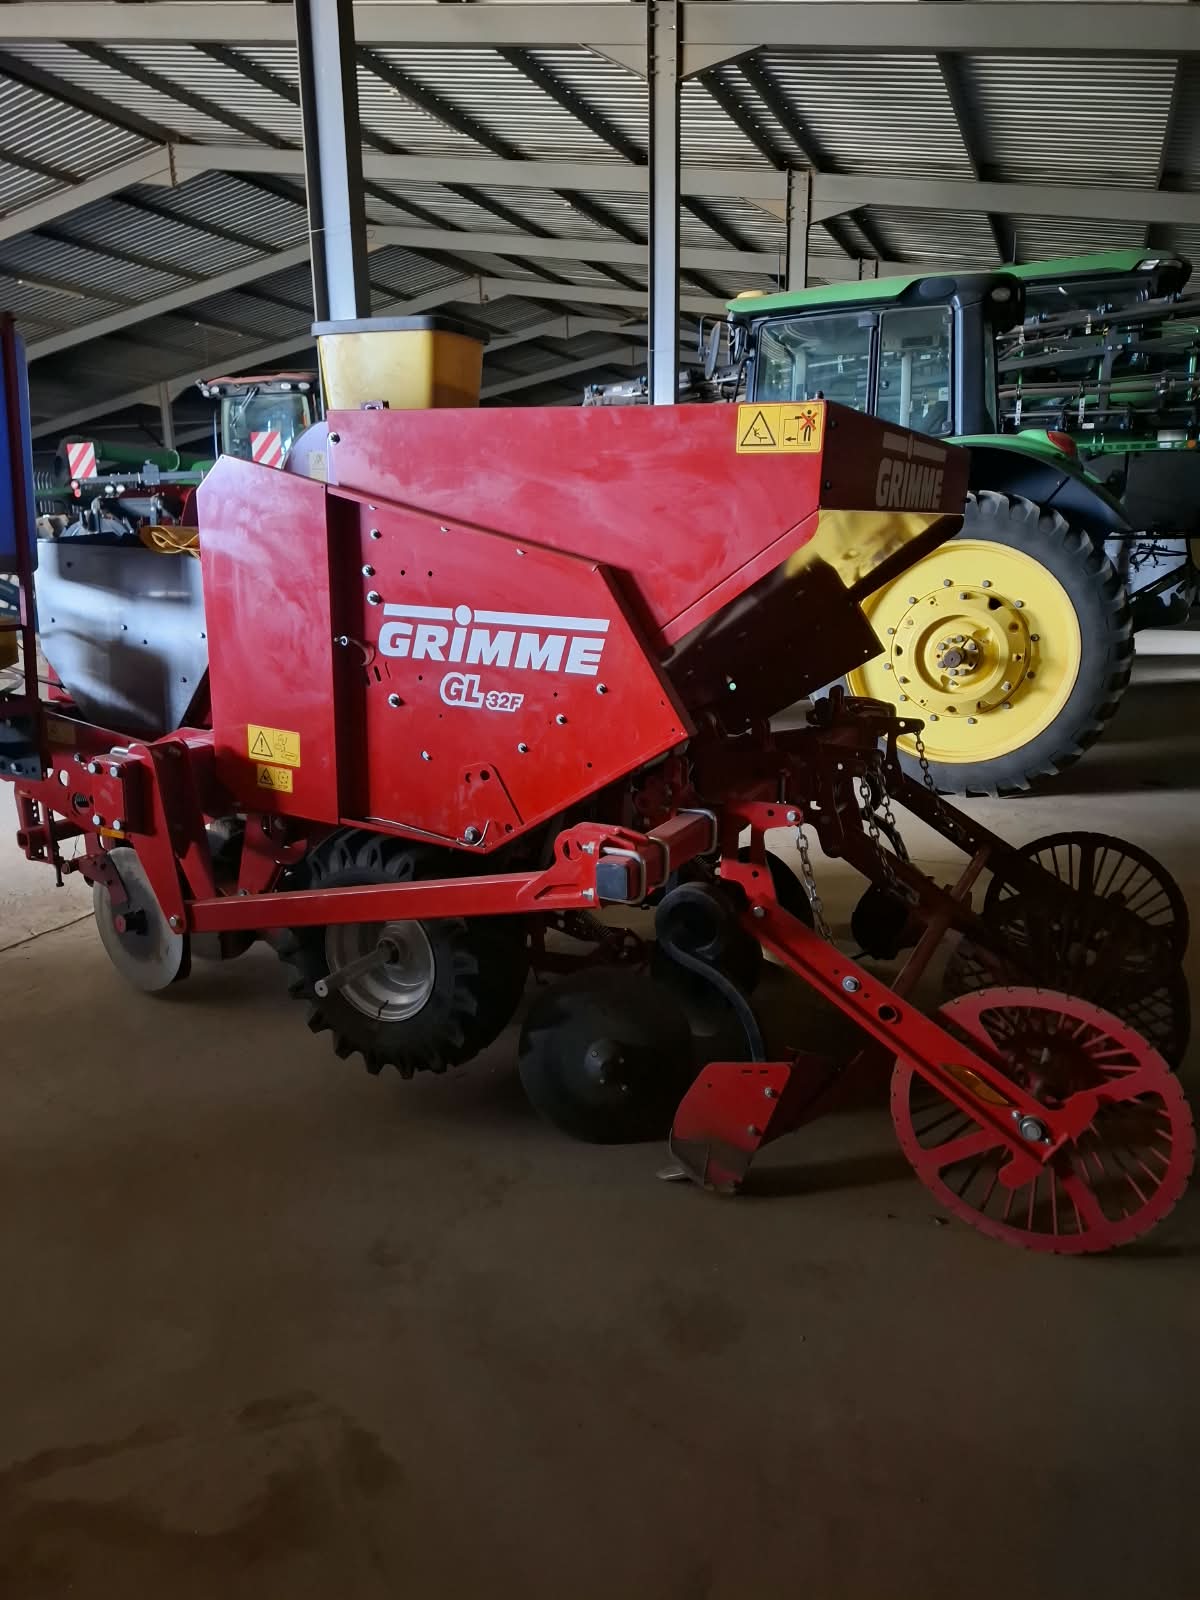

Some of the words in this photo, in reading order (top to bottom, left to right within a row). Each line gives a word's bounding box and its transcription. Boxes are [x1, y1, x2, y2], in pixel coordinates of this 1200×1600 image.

[876, 433, 945, 510] GRIMME
[377, 604, 606, 676] GRIMME
[439, 671, 484, 708] GL
[485, 690, 524, 712] 32F
